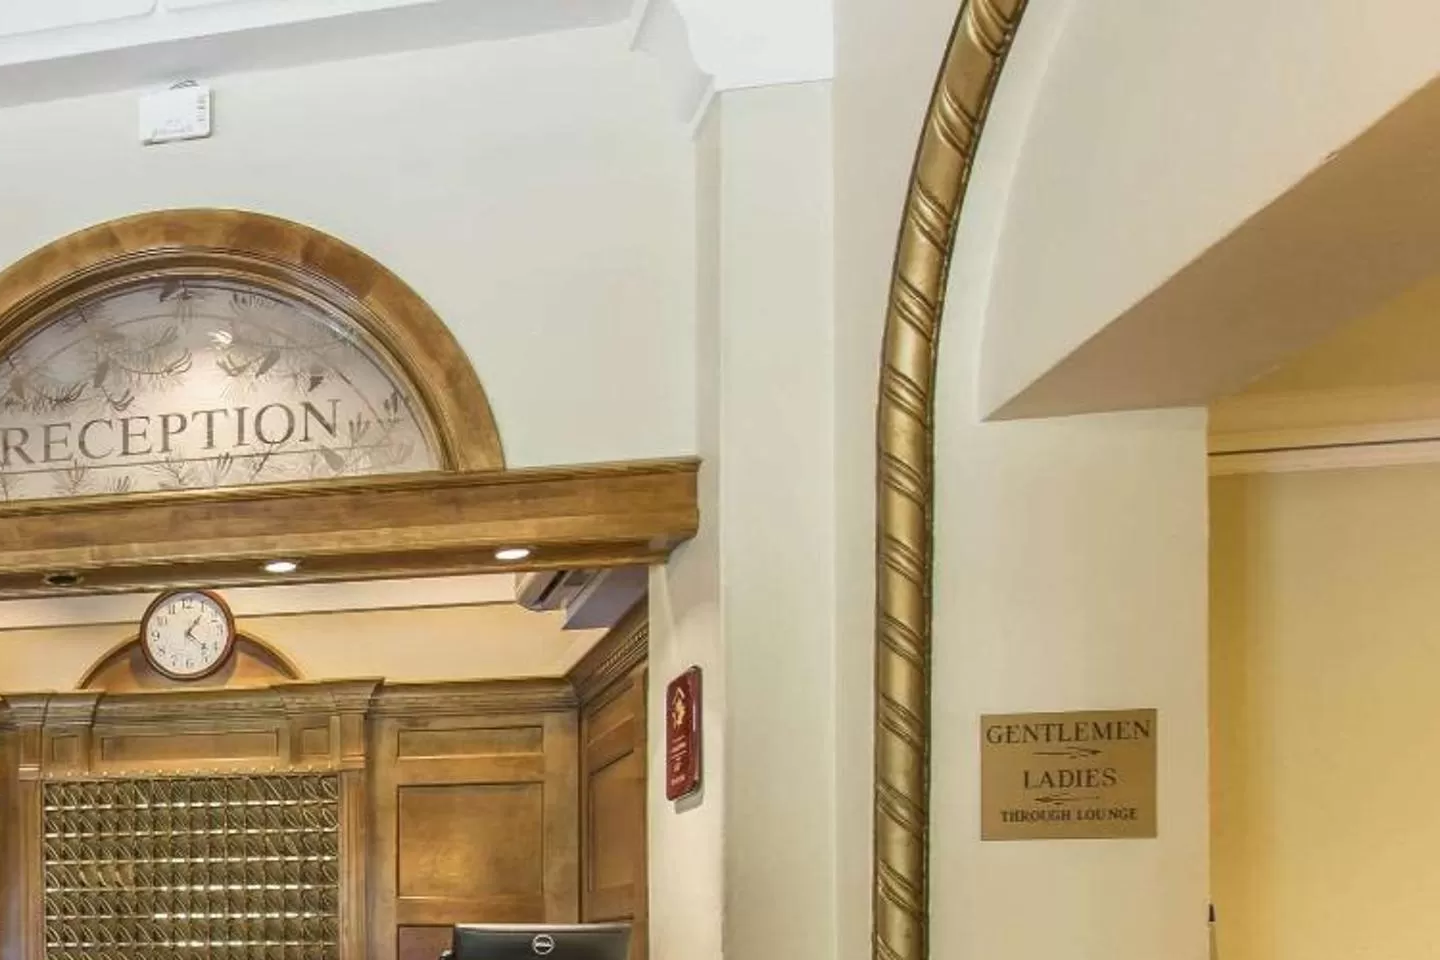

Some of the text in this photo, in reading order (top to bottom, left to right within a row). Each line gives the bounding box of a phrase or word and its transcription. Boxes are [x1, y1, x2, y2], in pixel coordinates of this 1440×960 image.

[986, 720, 1151, 744] GENTLEMEN
[1023, 768, 1118, 789] LADIES
[1000, 807, 1138, 823] THROUGH LOUNGE
